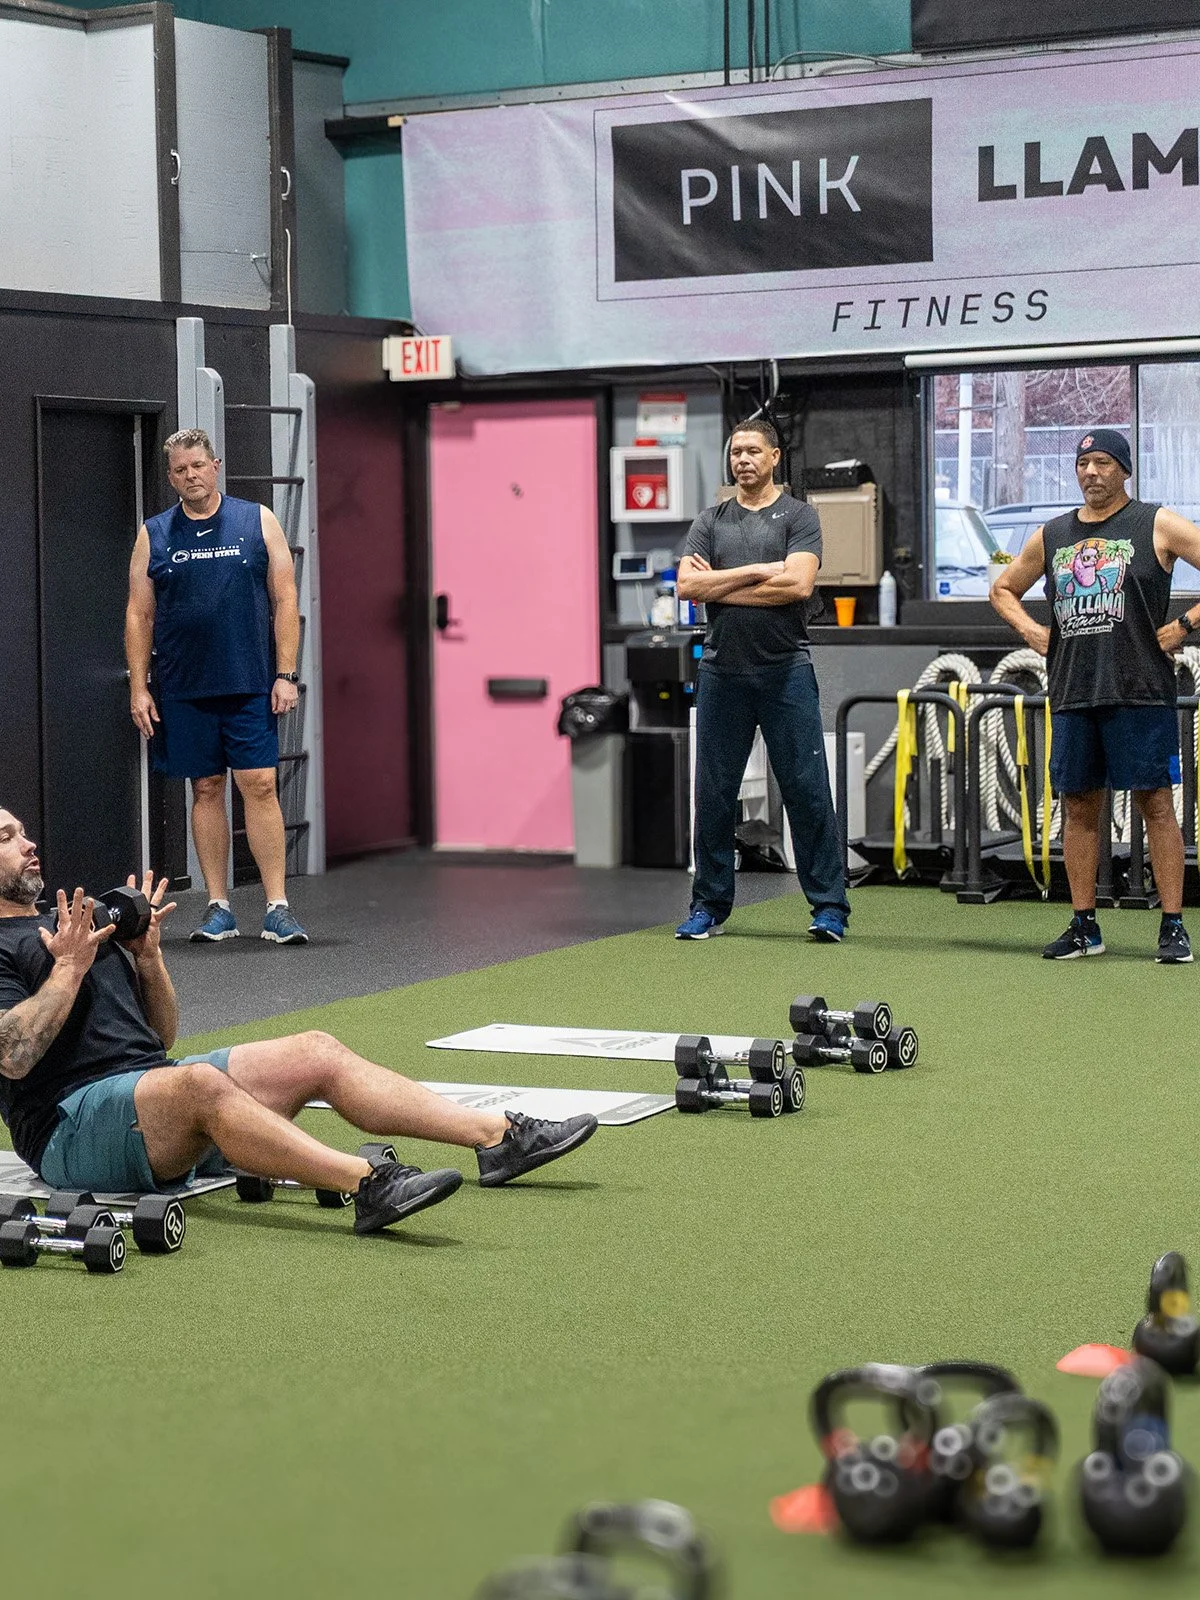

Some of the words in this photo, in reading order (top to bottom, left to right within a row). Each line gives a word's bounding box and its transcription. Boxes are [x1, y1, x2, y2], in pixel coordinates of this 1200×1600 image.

[680, 155, 862, 225] PINK
[978, 128, 1199, 202] LLAM
[832, 289, 1049, 332] FITNESS
[402, 340, 441, 374] EXIT
[215, 549, 240, 558] STATE
[1078, 592, 1123, 618] LLAMA
[877, 1011, 888, 1031] 15
[872, 1051, 884, 1064] 10
[901, 1035, 915, 1060] 20
[167, 1211, 182, 1241] 20
[113, 1243, 124, 1261] 10
